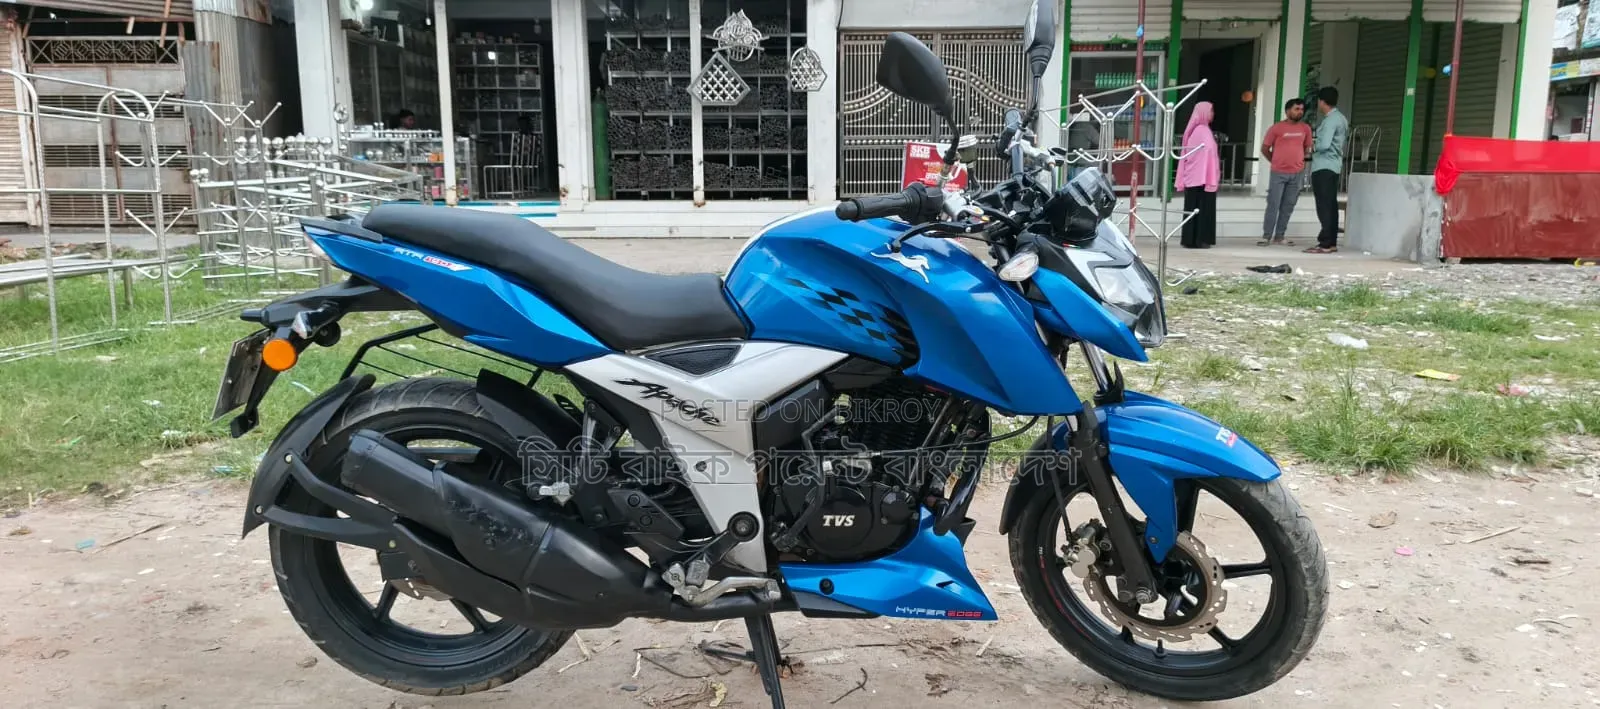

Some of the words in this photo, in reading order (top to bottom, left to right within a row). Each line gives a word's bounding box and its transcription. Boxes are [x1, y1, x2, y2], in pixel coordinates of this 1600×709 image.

[613, 379, 722, 426] Apache
[823, 515, 855, 526] TVS
[895, 605, 945, 616] HYPER
